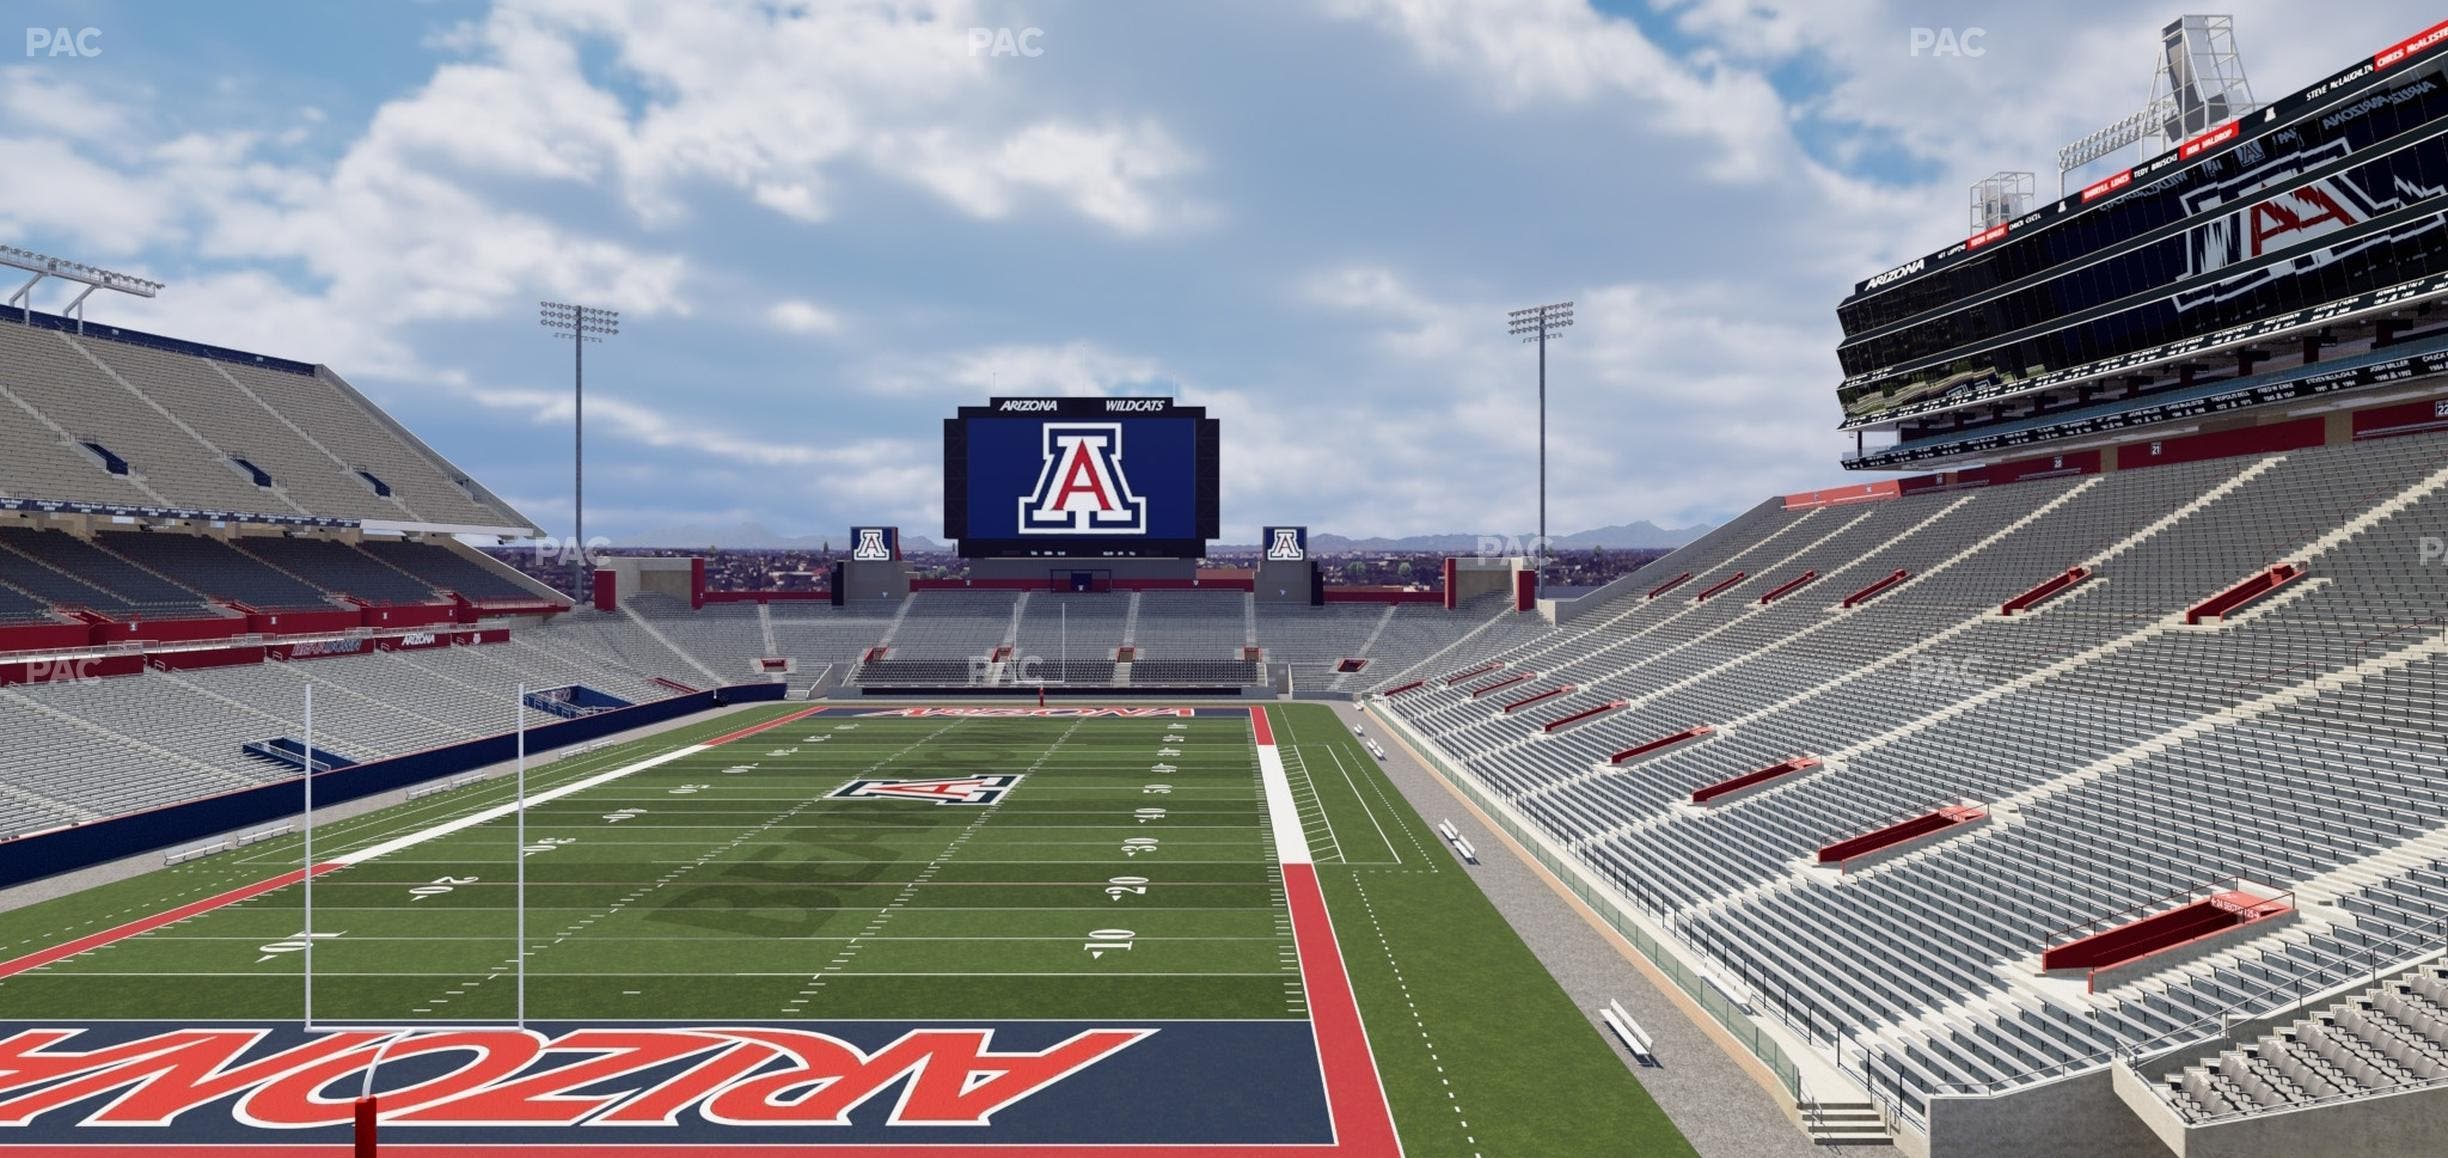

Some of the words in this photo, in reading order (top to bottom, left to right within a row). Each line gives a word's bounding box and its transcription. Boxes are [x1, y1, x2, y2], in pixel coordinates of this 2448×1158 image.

[2306, 84, 2327, 101] STEVE
[1864, 259, 1925, 291] ARIZONA
[1000, 400, 1057, 411] ARIZONA
[1105, 400, 1165, 411] WILDCATS
[1018, 422, 1146, 534] A
[854, 528, 890, 560] A
[1267, 528, 1303, 560] A
[402, 632, 435, 646] ARIZONA
[1121, 837, 1160, 852] 30
[409, 876, 479, 894] 20
[1105, 876, 1149, 895] 20
[259, 930, 349, 953] 10
[1084, 929, 1136, 951] 10
